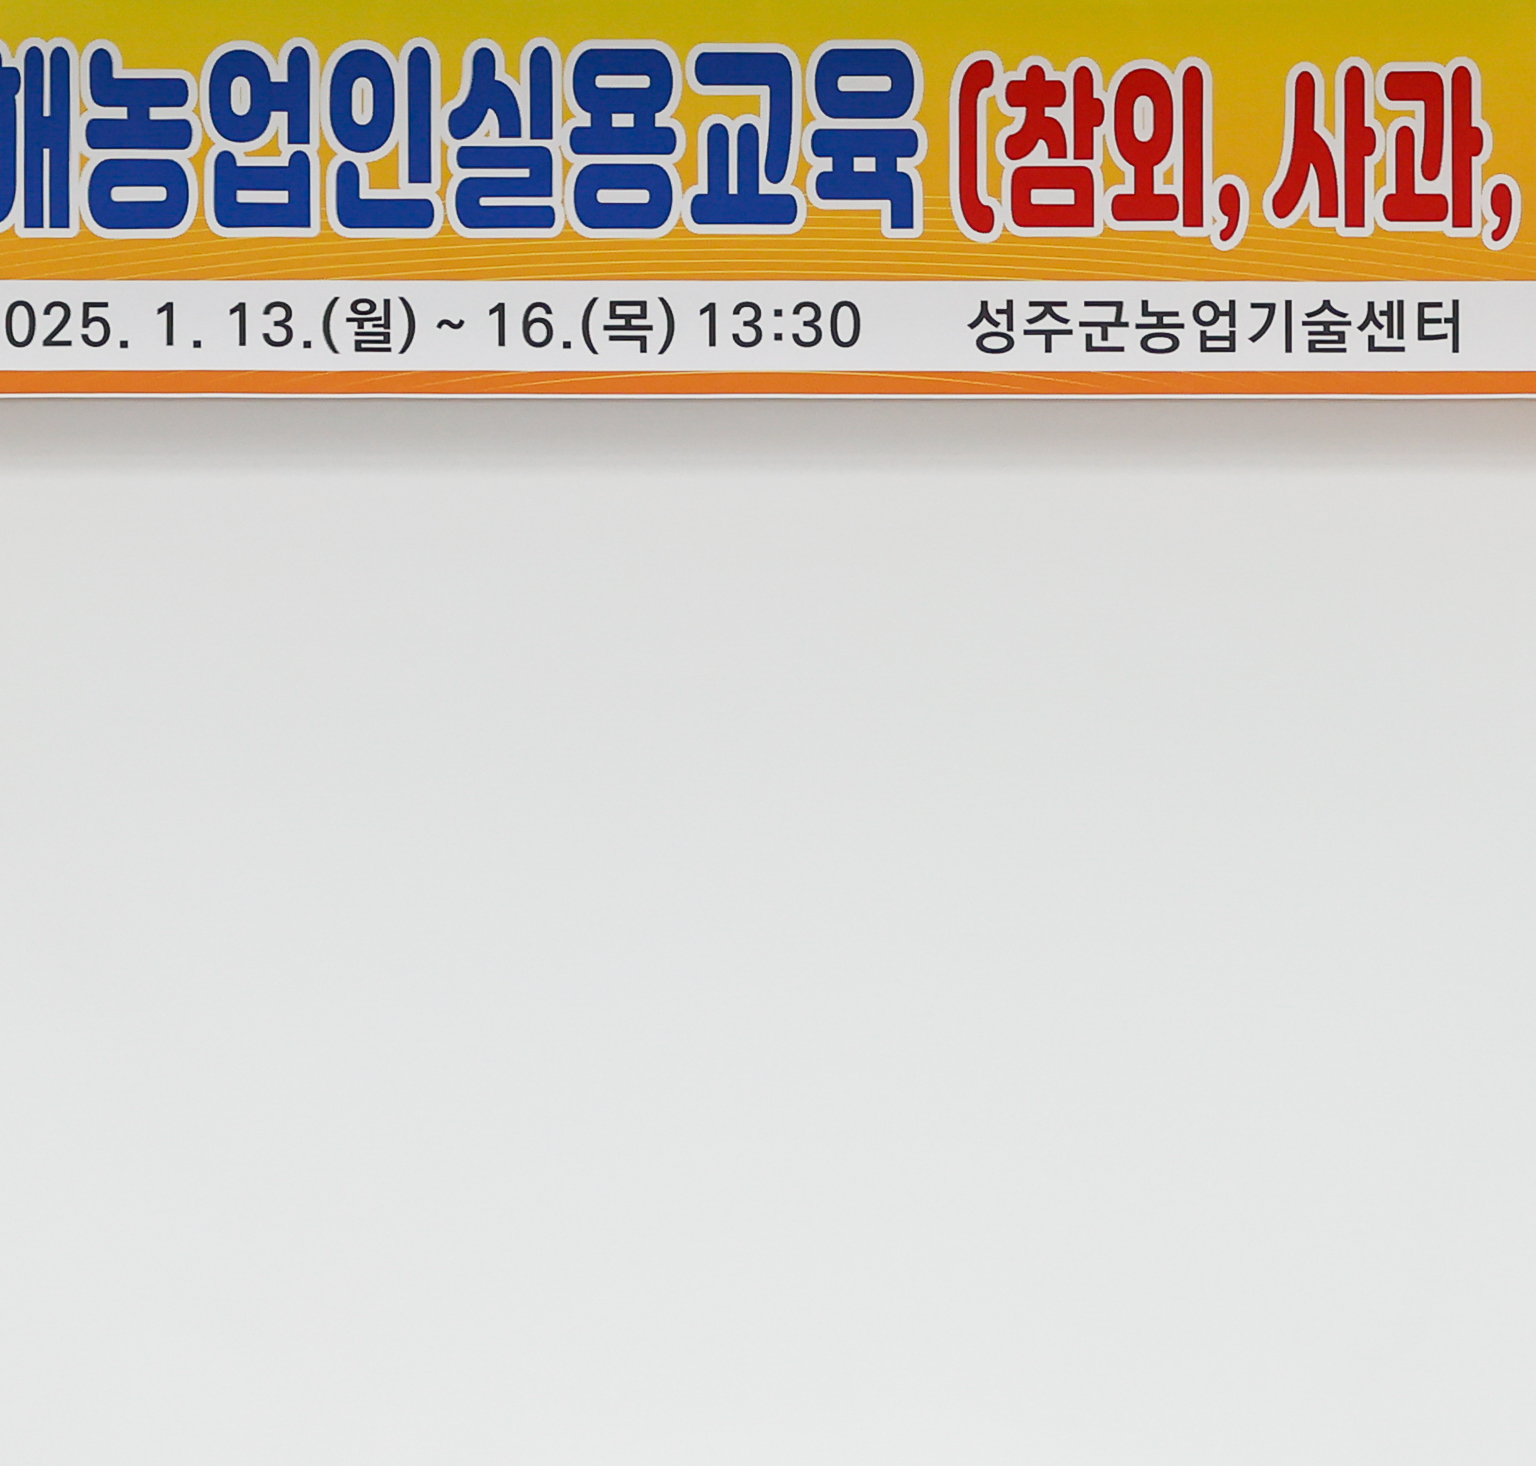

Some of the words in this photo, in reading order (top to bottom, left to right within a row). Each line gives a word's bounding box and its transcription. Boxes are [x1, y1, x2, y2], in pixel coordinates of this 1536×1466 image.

[957, 58, 1242, 244] (참외,
[1270, 62, 1514, 244] 사과,
[155, 298, 204, 350] 1.
[227, 295, 419, 355] 13.(월)
[435, 316, 467, 334] ~
[487, 295, 677, 355] 16.(목)
[698, 298, 863, 350] 13:30
[967, 296, 1463, 355] 성주군농업기술센터
